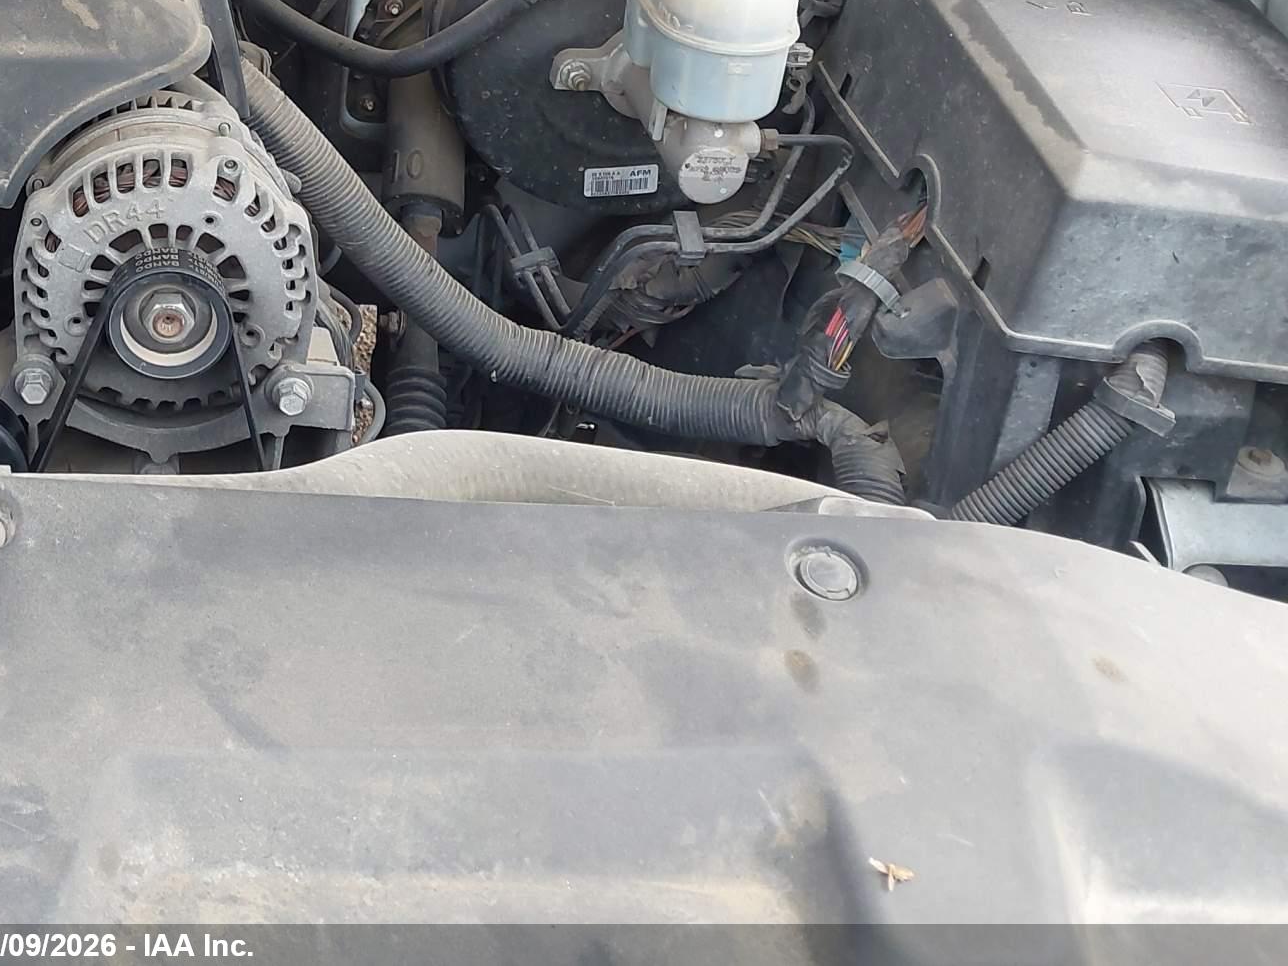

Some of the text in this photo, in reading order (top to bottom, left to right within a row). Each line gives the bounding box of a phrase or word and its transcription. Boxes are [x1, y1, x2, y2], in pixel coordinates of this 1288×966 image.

[629, 169, 651, 178] AFM
[83, 198, 165, 244] DR44
[135, 254, 179, 266] BANDO
[135, 261, 180, 273] BANDO
